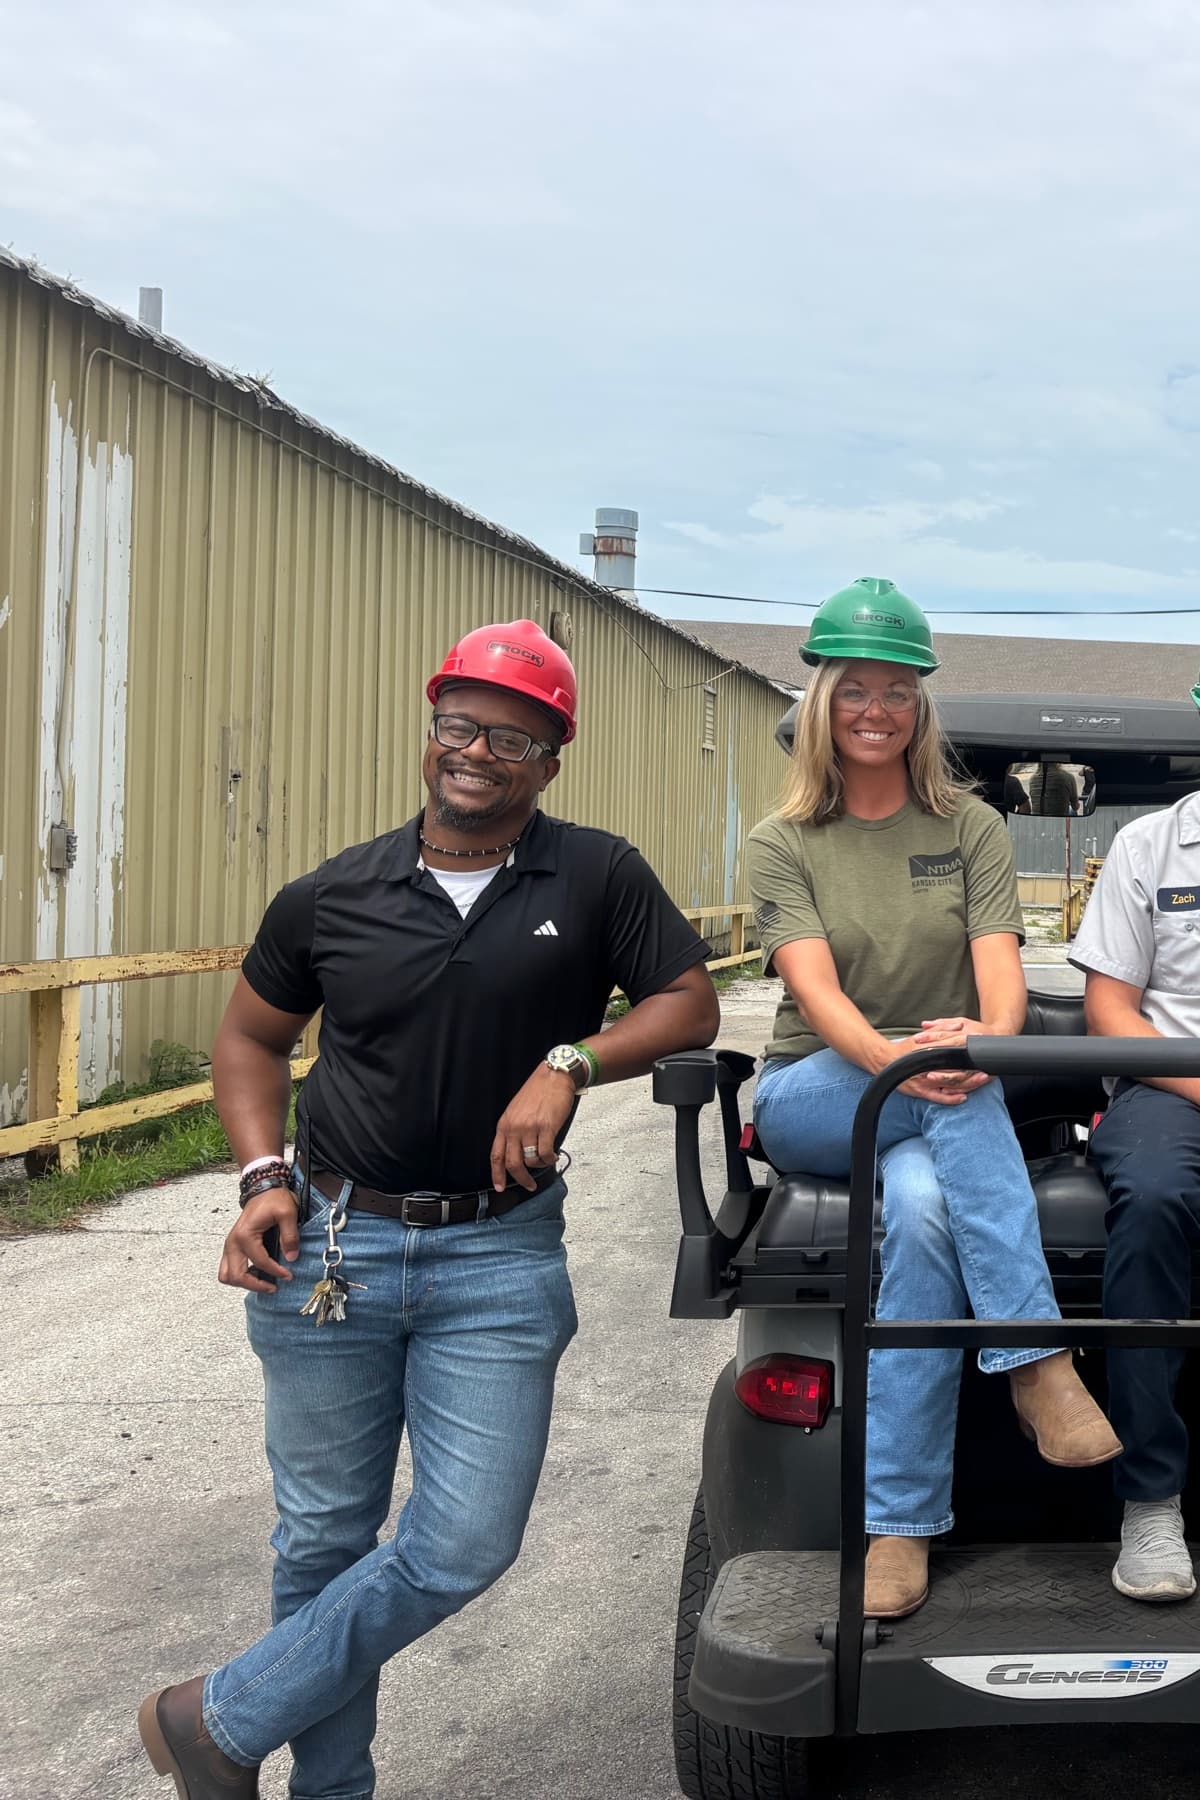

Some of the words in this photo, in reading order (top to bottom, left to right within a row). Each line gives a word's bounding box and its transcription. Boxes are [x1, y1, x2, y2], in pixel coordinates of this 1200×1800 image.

[855, 613, 903, 626] BROCK
[489, 642, 542, 666] BROCK
[927, 857, 964, 875] NTMA
[911, 879, 936, 888] KANSAS
[937, 877, 952, 887] CITY
[1171, 893, 1196, 905] Zach
[1130, 1660, 1166, 1669] 300
